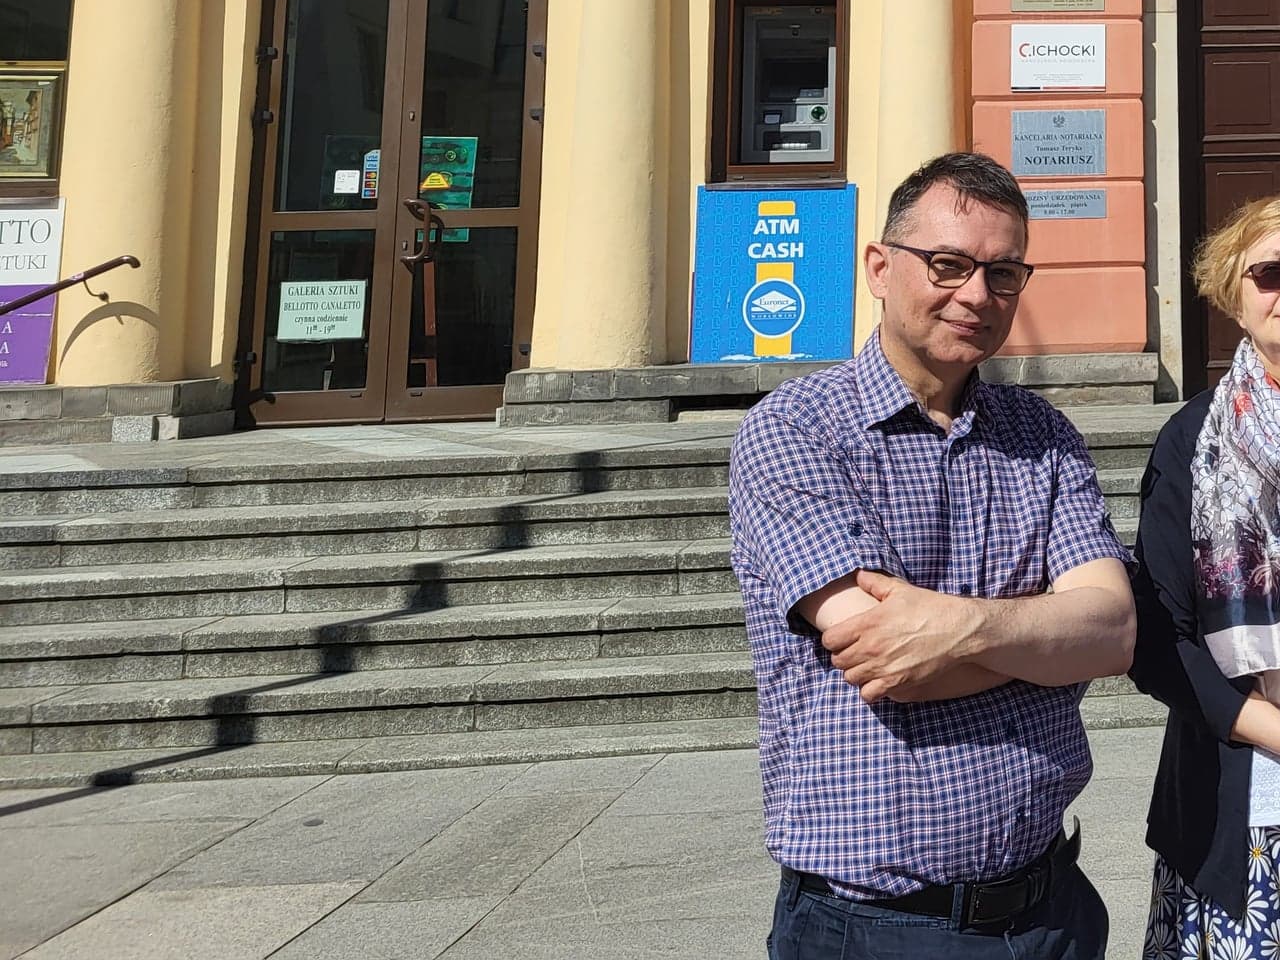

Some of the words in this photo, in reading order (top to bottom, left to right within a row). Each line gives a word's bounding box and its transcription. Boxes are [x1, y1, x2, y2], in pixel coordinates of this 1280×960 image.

[1060, 133, 1103, 141] NOTARIALNA
[1024, 155, 1094, 166] NOTARIUSZ
[753, 218, 800, 235] ATM
[747, 242, 804, 259] CASH
[288, 286, 325, 296] GALERIA
[328, 285, 358, 296] SZTUKI
[284, 302, 318, 311] BELLOTTO
[321, 301, 361, 311] CANALETTO
[760, 297, 790, 306] Euronet
[316, 313, 348, 323] codziennie
